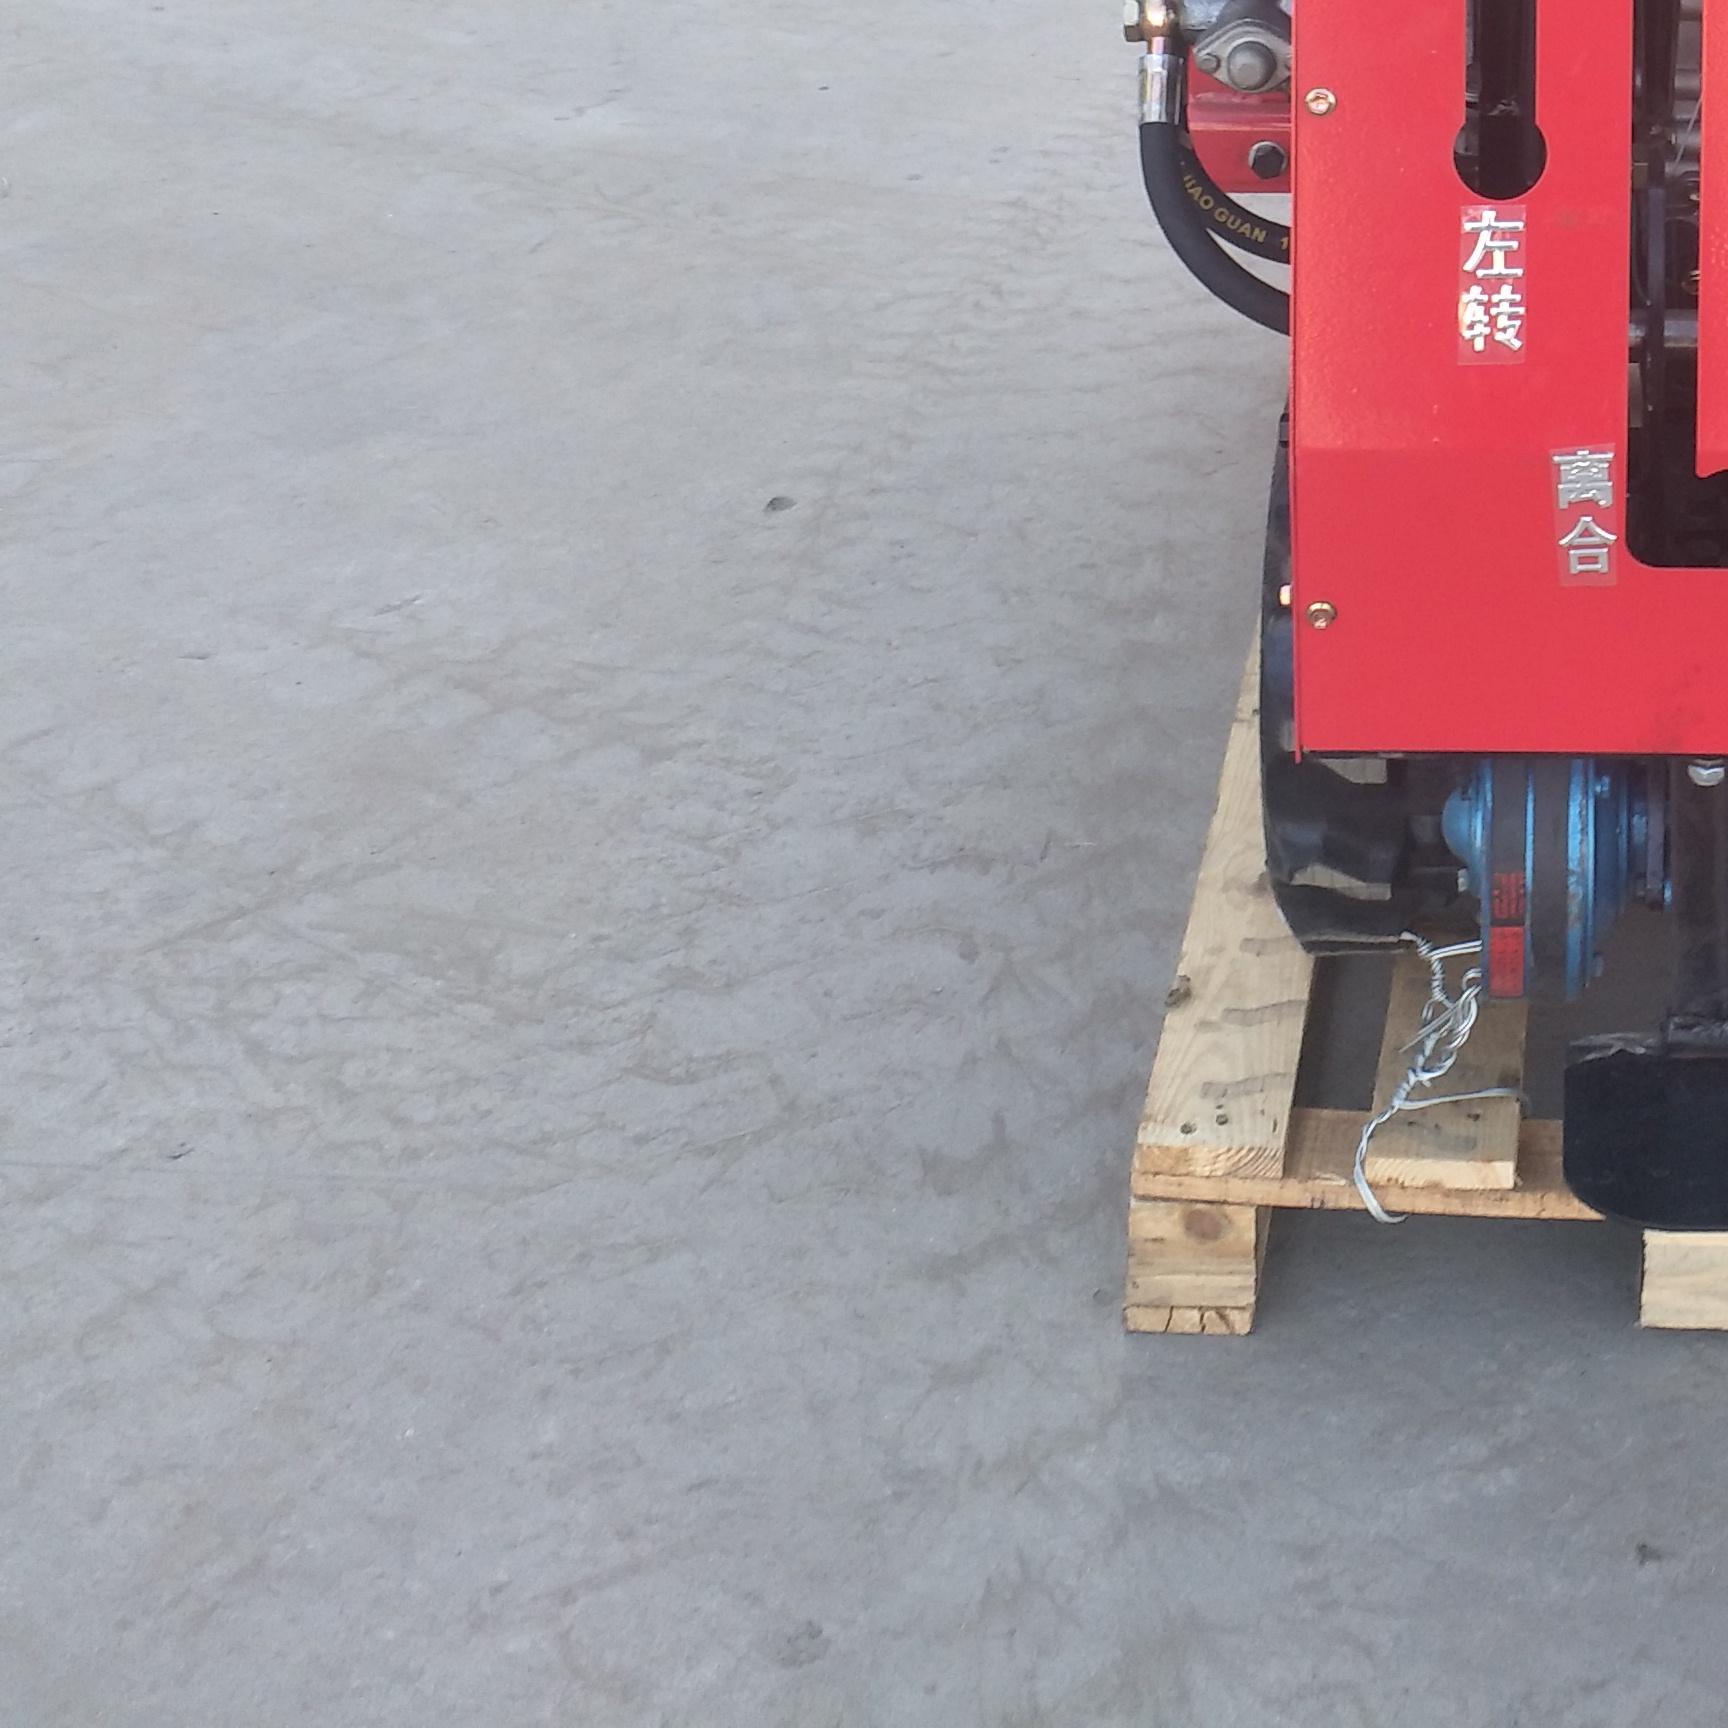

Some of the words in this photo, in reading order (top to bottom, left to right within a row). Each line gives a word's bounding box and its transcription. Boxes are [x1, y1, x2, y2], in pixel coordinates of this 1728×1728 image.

[1214, 207, 1268, 243] GUAN
[1462, 210, 1526, 352] 左转
[1552, 450, 1618, 574] 离合
